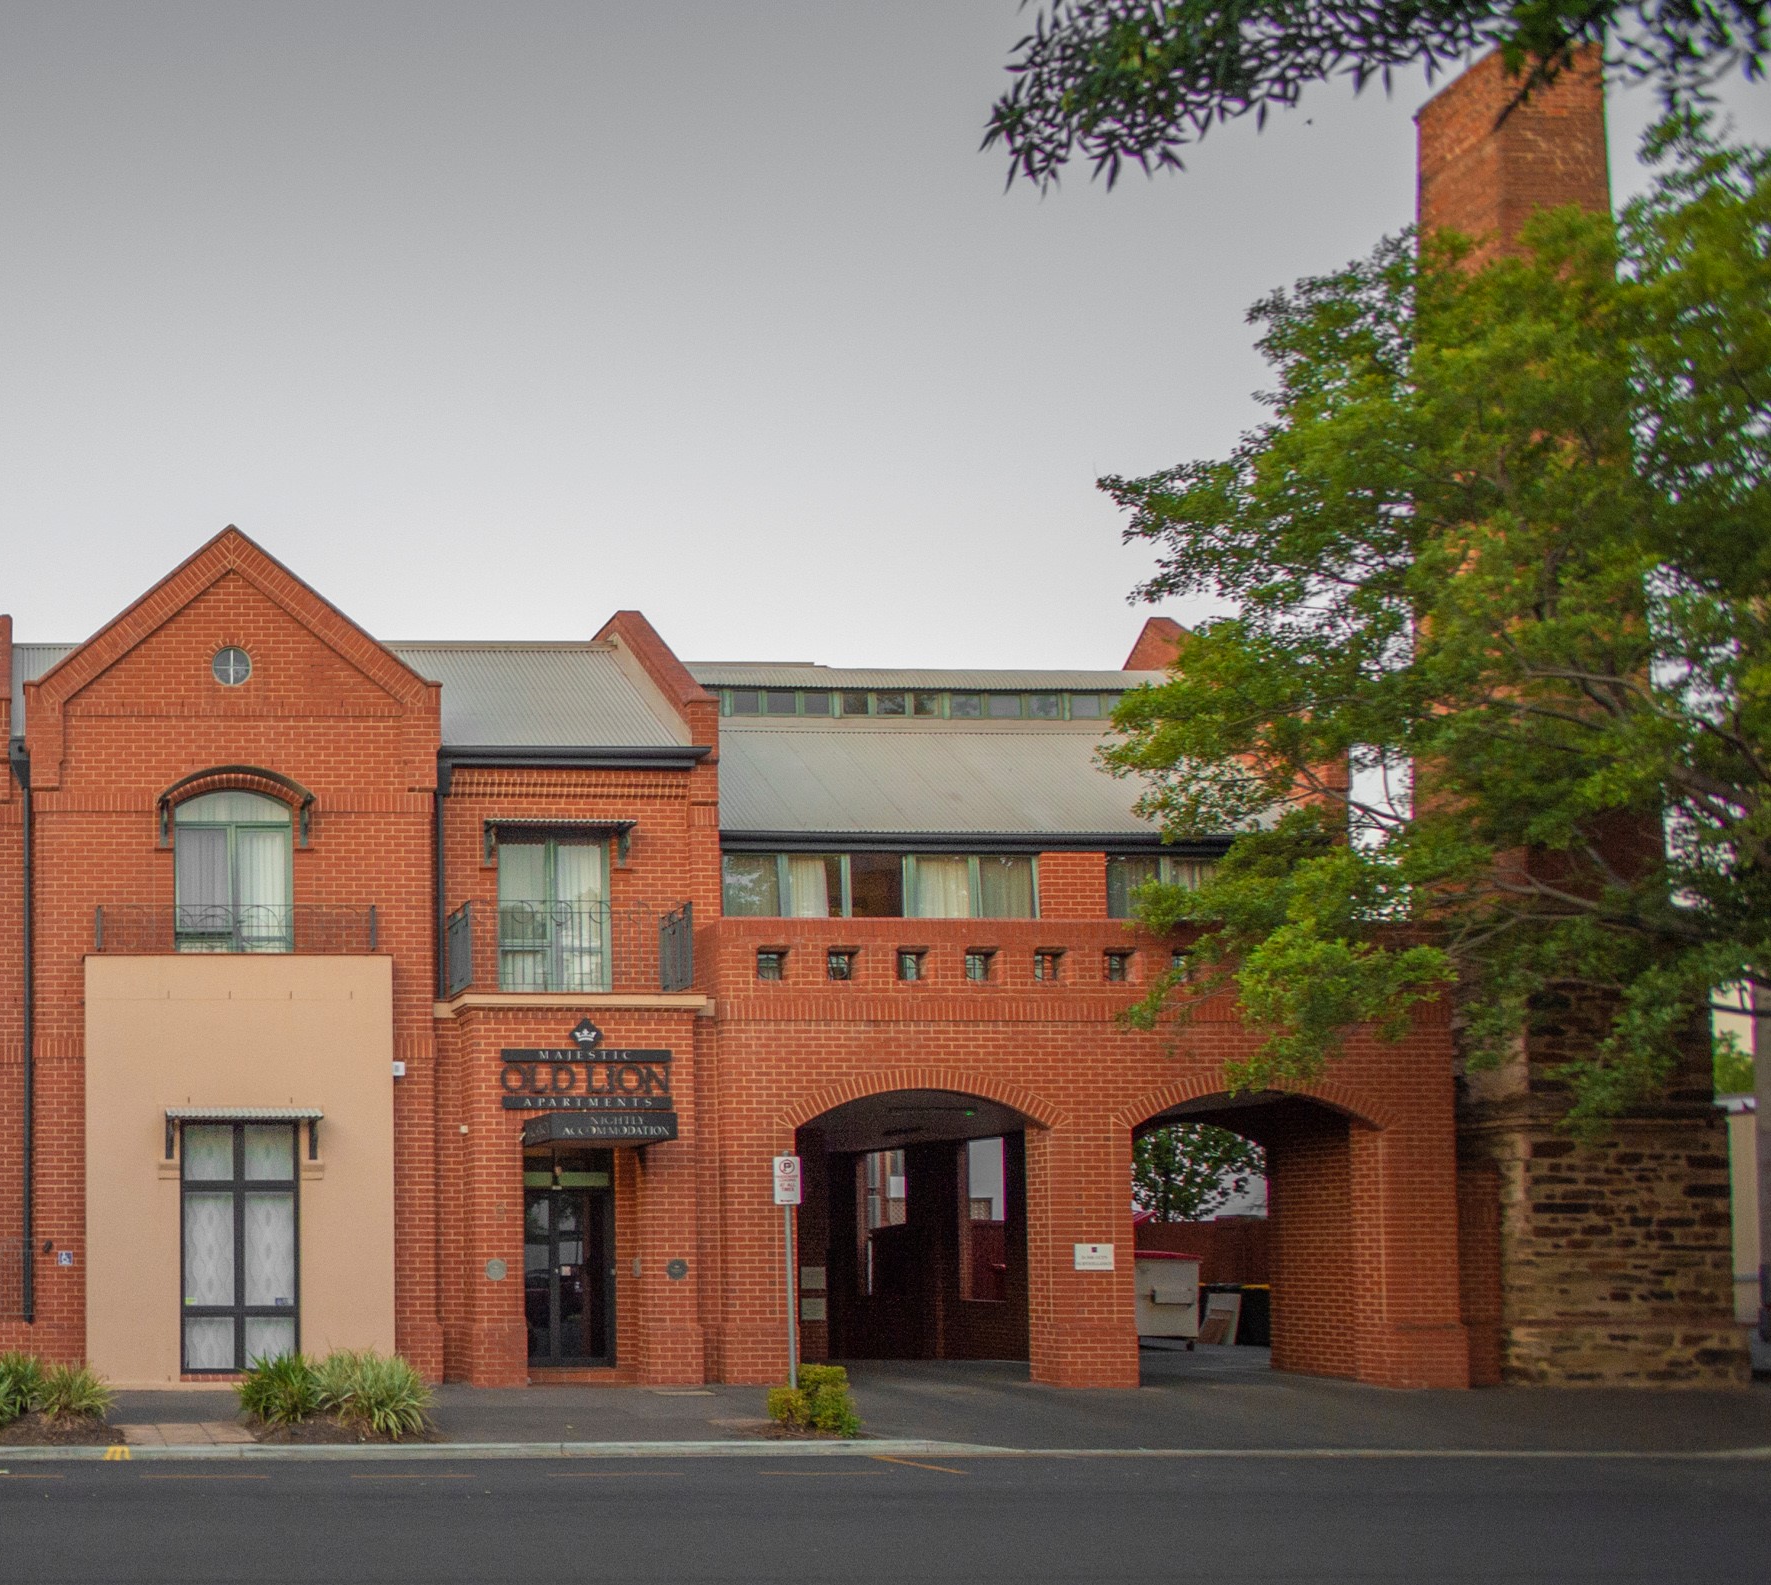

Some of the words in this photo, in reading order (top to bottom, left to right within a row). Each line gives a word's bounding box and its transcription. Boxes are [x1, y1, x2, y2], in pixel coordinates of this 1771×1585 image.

[539, 1051, 632, 1060] MAJESTIC
[500, 1064, 576, 1093] OLD
[586, 1064, 671, 1093] LION
[523, 1098, 653, 1107] APARTMENTS
[590, 1116, 644, 1125] NIGHTLY
[562, 1126, 670, 1136] ACCOMMODATION
